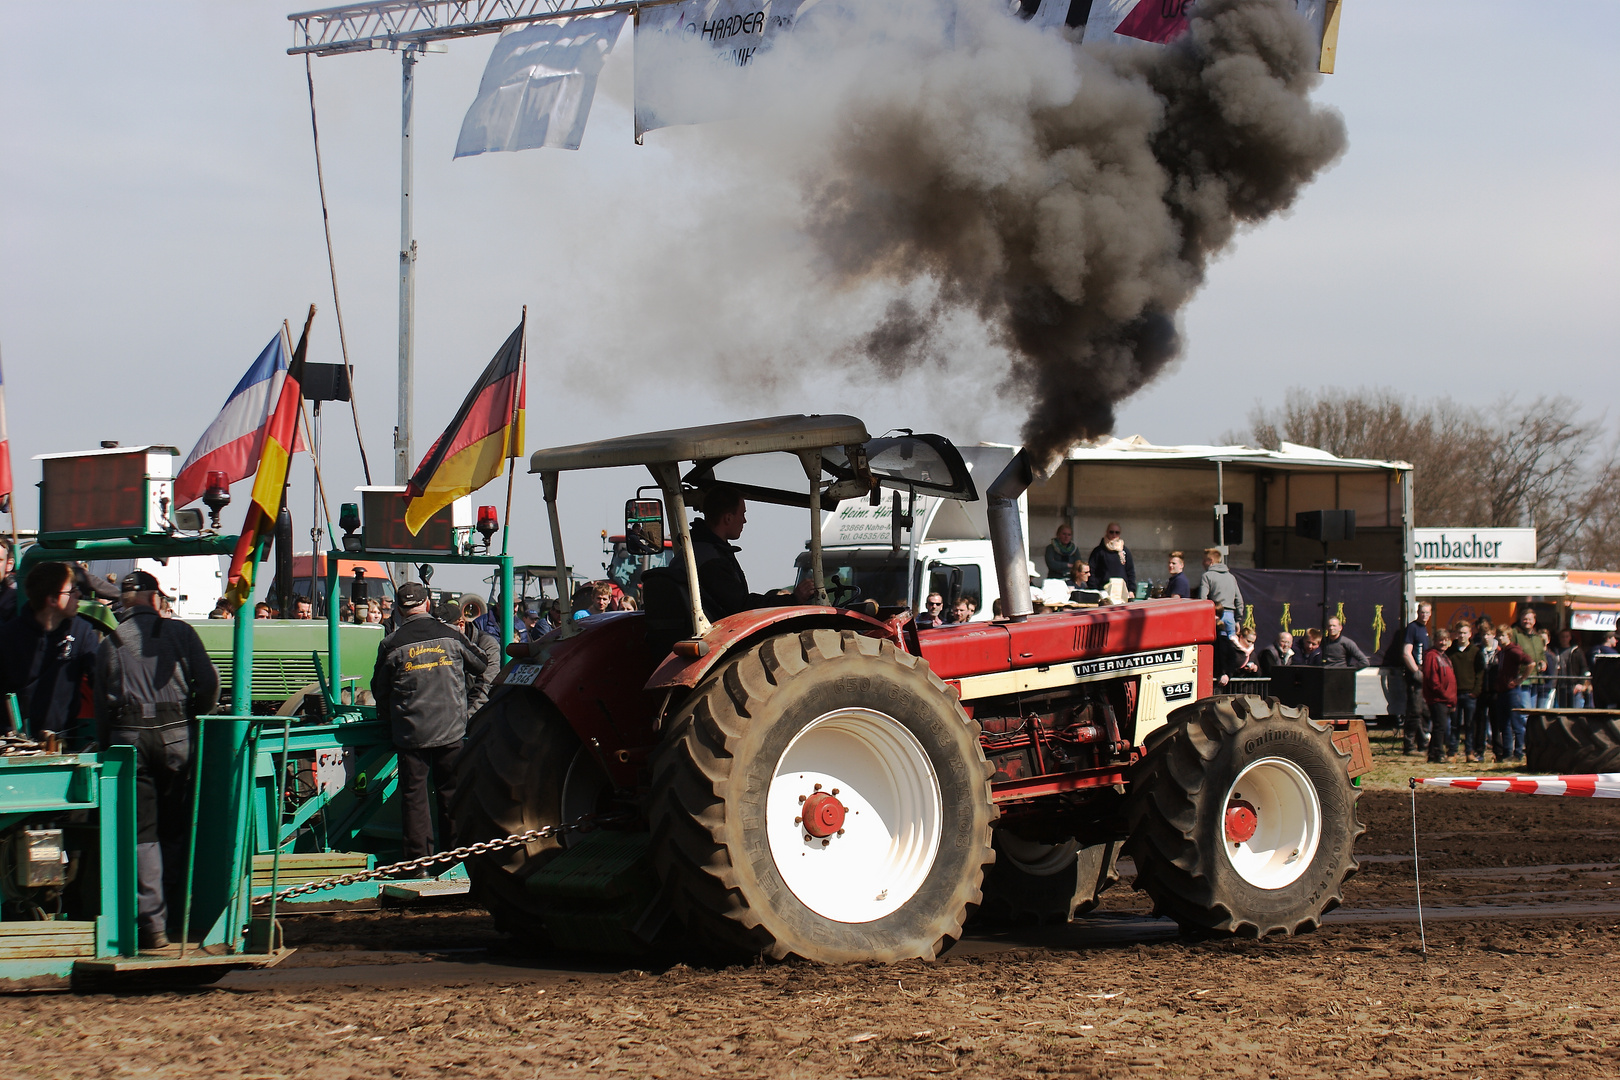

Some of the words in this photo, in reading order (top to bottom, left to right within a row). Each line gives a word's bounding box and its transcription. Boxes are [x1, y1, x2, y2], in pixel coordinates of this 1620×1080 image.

[701, 11, 765, 41] HARDER
[840, 506, 869, 520] Heinr.
[840, 533, 851, 541] Tel.
[1414, 533, 1502, 559] ombacher
[1076, 653, 1181, 676] INTERNATIONAL
[1166, 683, 1190, 695] 946
[1244, 729, 1314, 754] Continental
